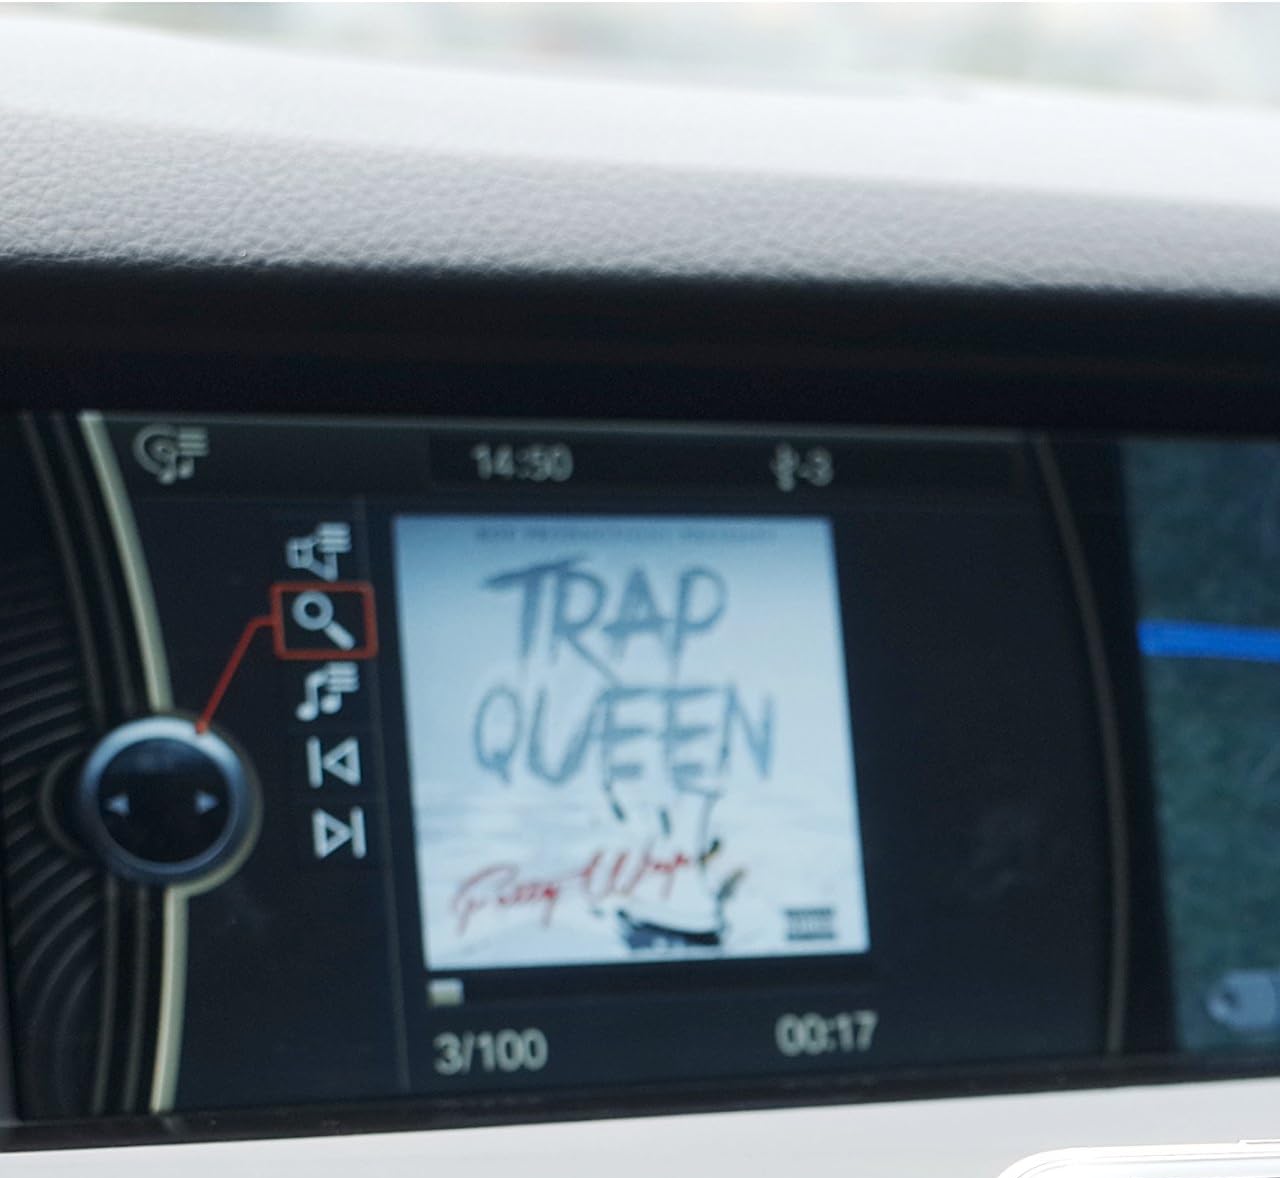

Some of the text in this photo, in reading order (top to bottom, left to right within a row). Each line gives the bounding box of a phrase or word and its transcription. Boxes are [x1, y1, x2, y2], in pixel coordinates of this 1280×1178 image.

[483, 551, 729, 680] TRAP
[474, 680, 773, 797] QUEEN
[434, 1028, 549, 1076] 3/100
[775, 1010, 877, 1057] 00:17
